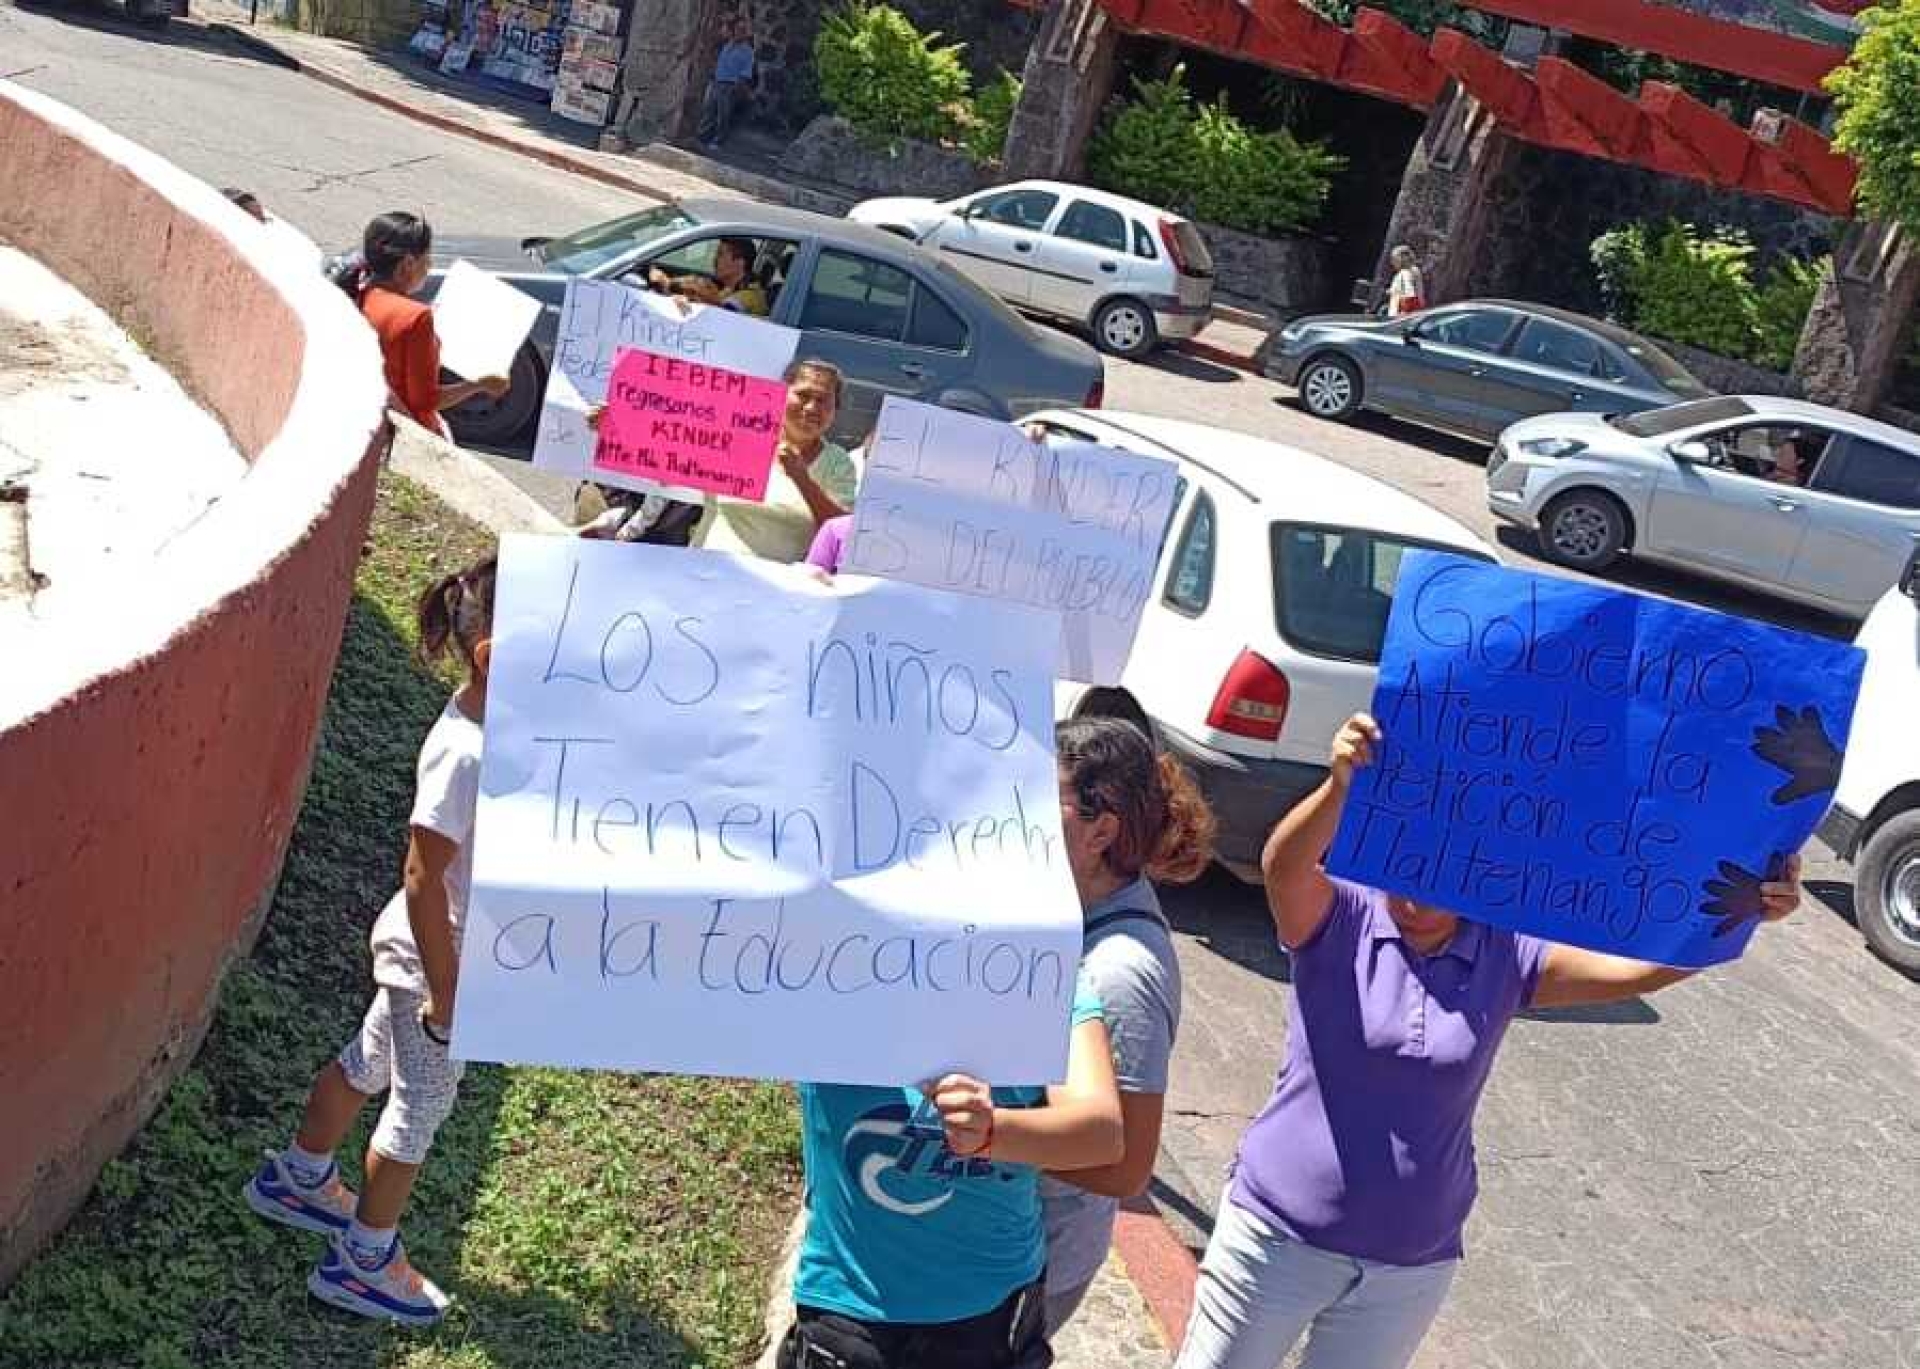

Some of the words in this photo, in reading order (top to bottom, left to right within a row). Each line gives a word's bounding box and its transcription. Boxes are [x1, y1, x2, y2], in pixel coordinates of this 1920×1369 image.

[645, 354, 748, 394] IEBEM
[651, 420, 734, 451] KINDER
[871, 404, 942, 484] EL
[852, 498, 908, 573] ES
[543, 556, 720, 705] Los
[806, 632, 1022, 751] niños
[1415, 563, 1754, 710] Gobierno
[1385, 660, 1611, 766] Atiende
[1648, 706, 1714, 803] la
[534, 736, 824, 866] Tienen
[1584, 783, 1680, 862] de
[493, 912, 556, 973] a
[599, 886, 661, 979] la
[698, 898, 1067, 995] Educacion
